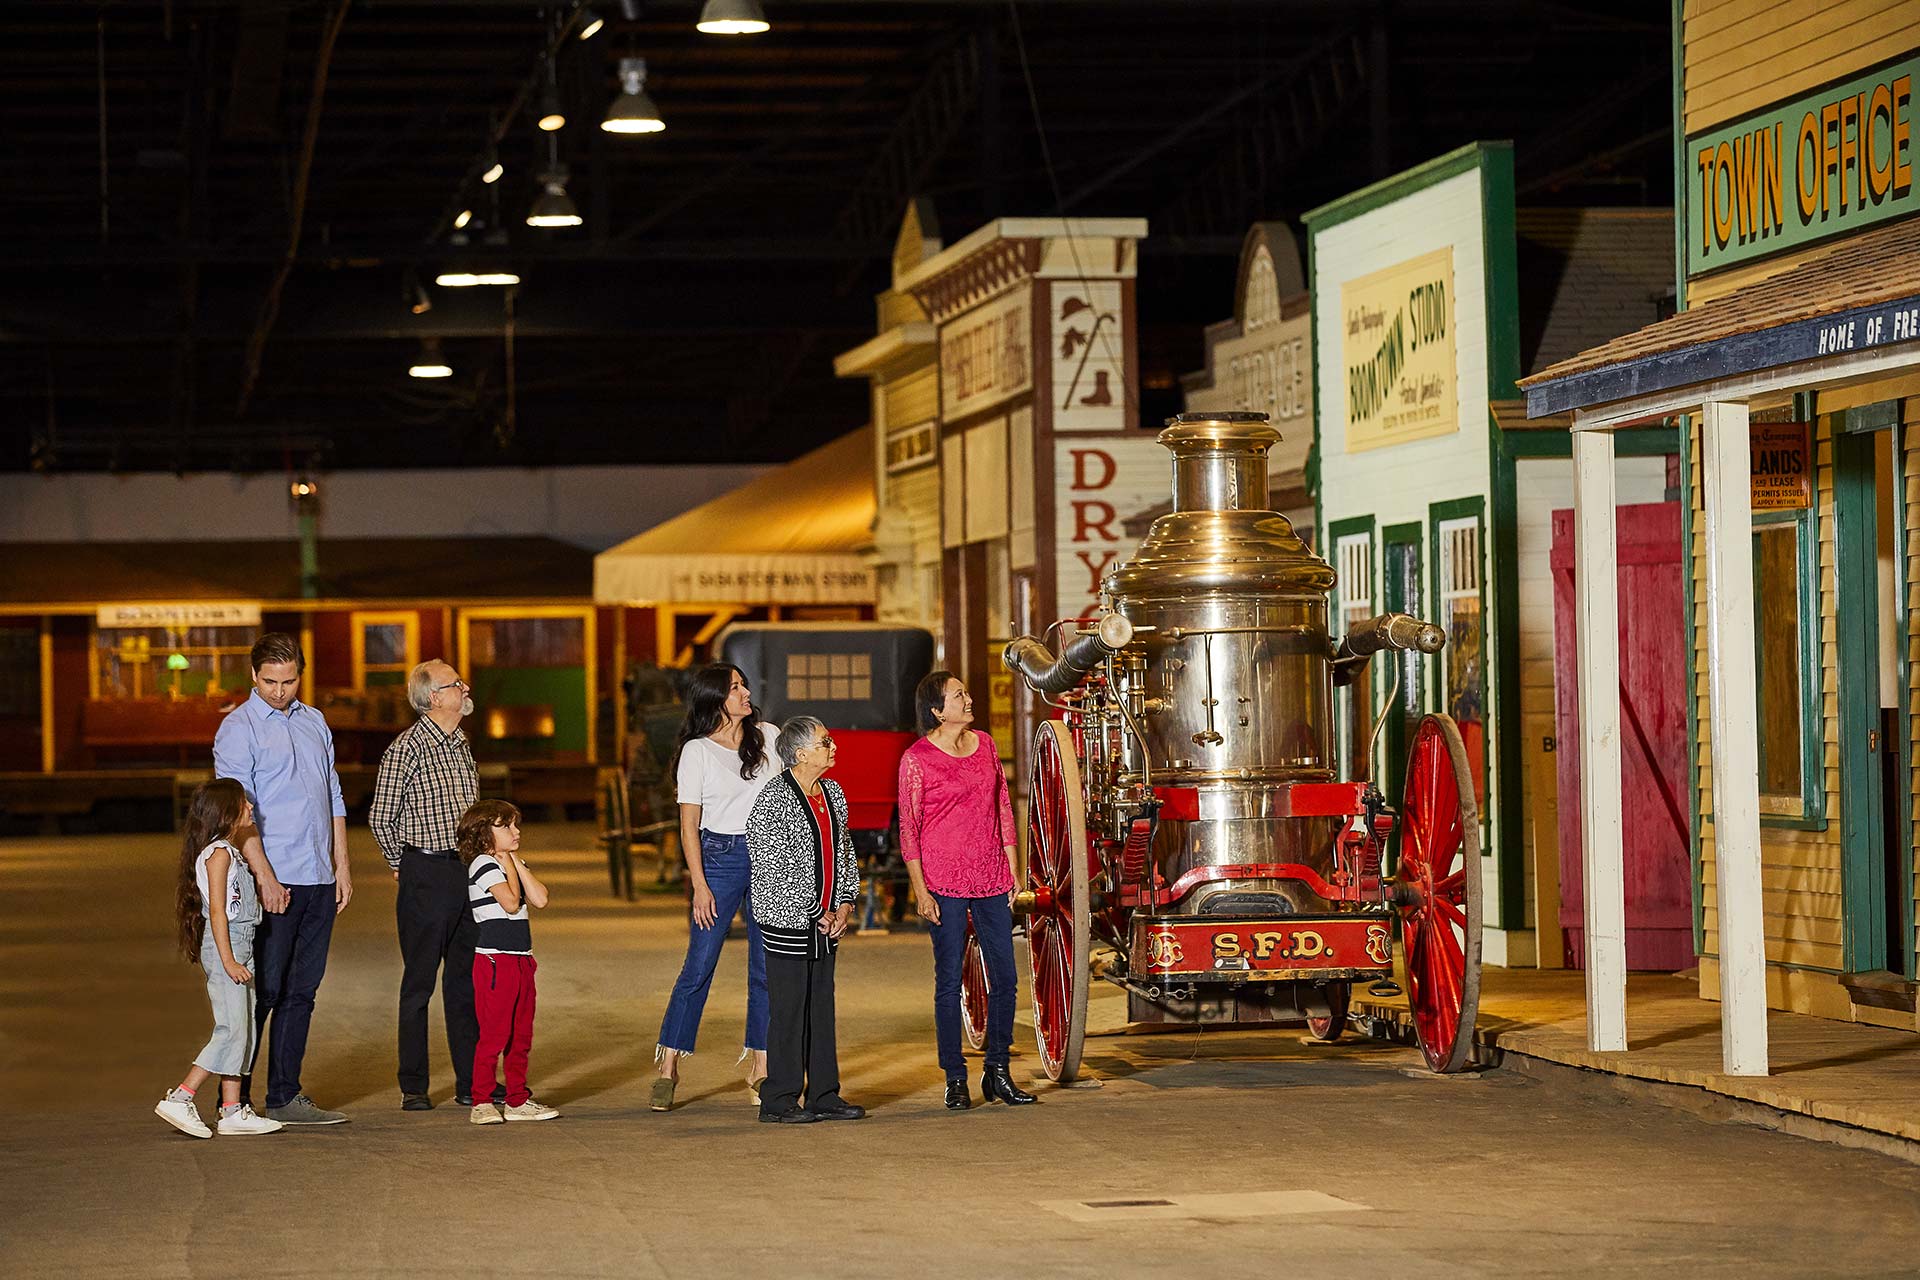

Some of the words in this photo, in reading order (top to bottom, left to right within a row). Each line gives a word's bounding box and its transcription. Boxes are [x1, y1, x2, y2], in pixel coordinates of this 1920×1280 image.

[1698, 121, 1783, 257] TOWN
[1796, 73, 1912, 227] OFFICE
[1818, 321, 1855, 354] HOME
[1866, 316, 1883, 344] OF
[1893, 309, 1920, 340] FRE
[1349, 306, 1404, 425] BOOMTOWN
[1409, 279, 1446, 353] STUDIO
[1750, 449, 1802, 475] LANDS
[1753, 489, 1780, 498] PERMITS
[1782, 488, 1804, 497] ISSUED
[1770, 477, 1794, 487] LEASE
[1069, 448, 1119, 594] DRY
[1212, 930, 1334, 960] S.F.D.
